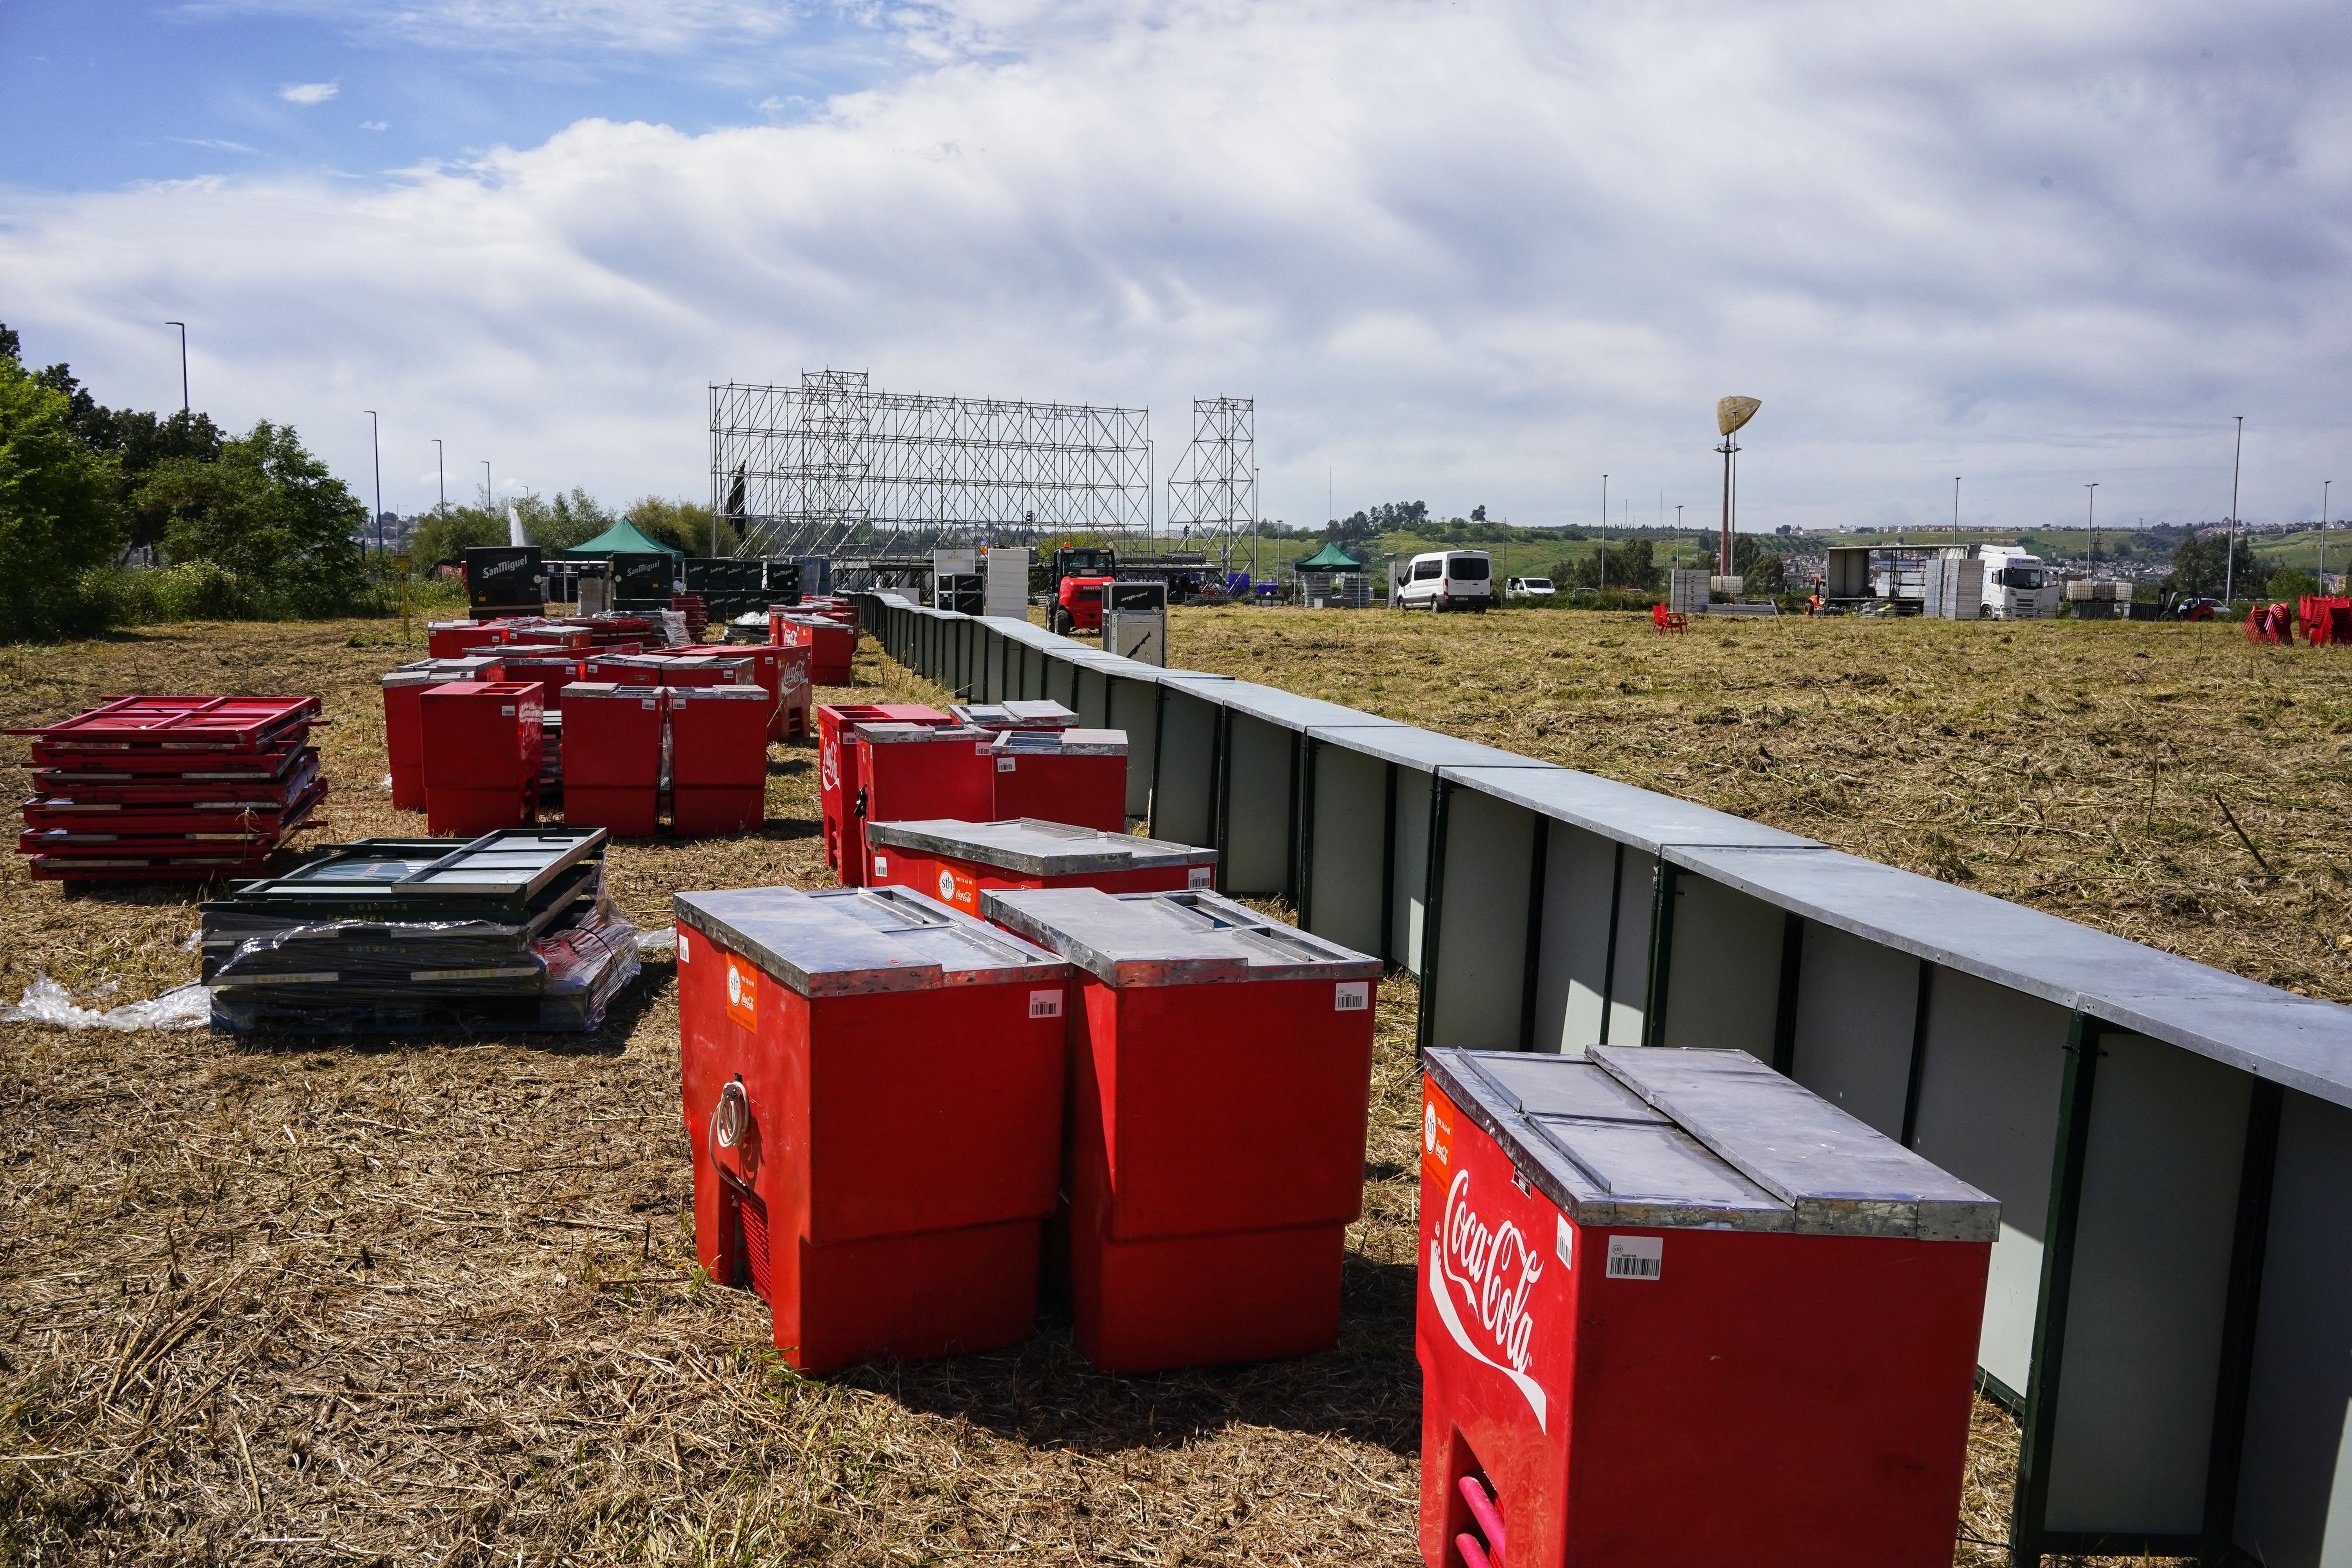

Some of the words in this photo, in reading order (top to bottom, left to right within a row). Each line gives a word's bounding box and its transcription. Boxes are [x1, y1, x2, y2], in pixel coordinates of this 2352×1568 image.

[942, 877, 952, 890] sth
[731, 975, 739, 992] sth
[1443, 1169, 1544, 1374] Coca-Cola
